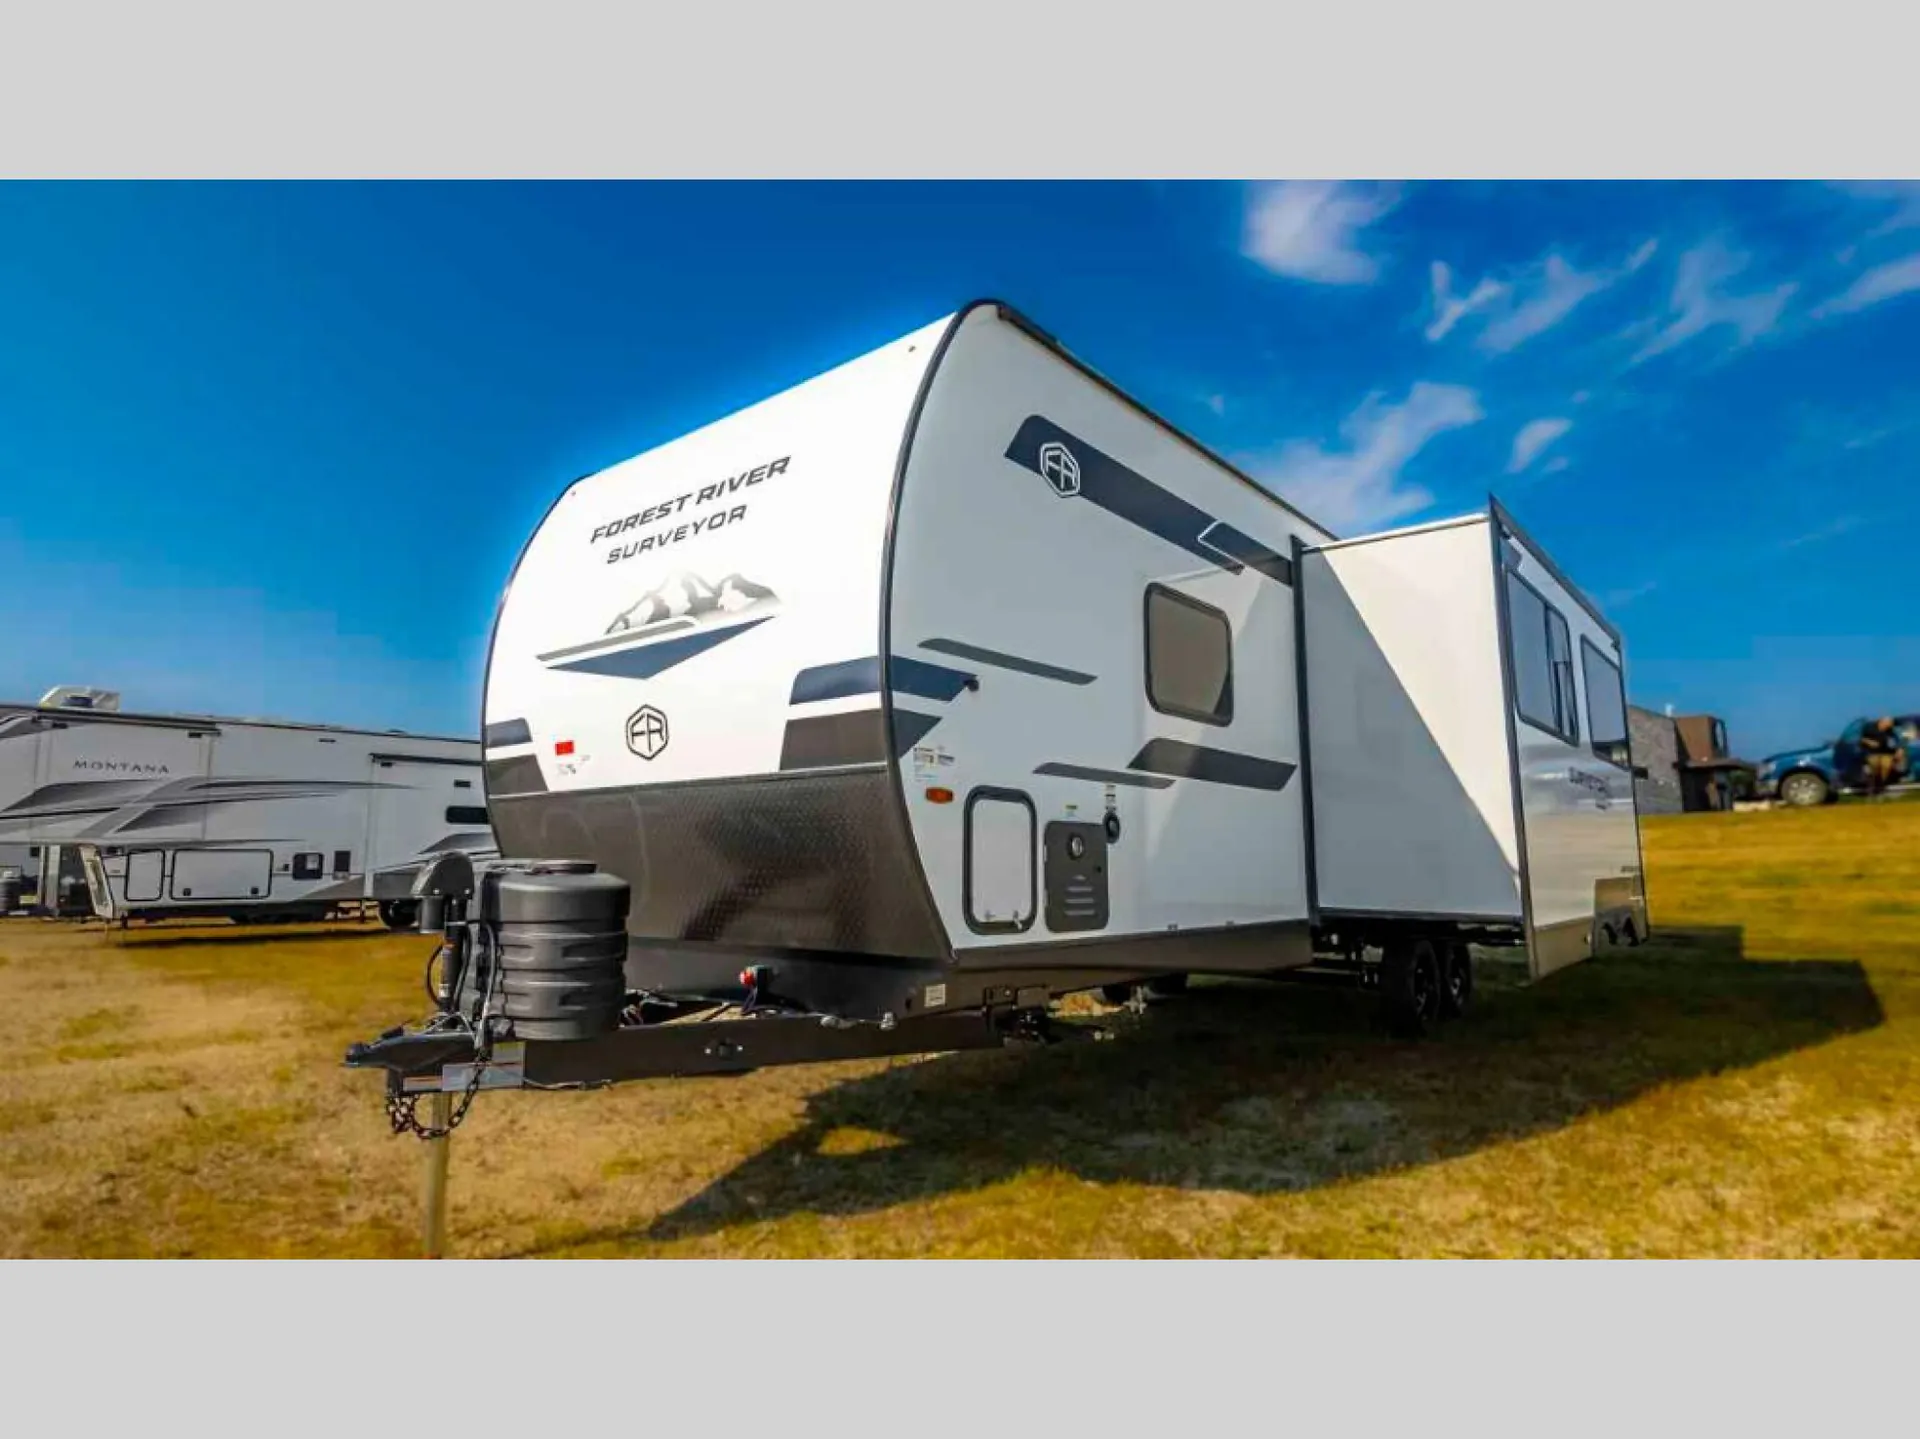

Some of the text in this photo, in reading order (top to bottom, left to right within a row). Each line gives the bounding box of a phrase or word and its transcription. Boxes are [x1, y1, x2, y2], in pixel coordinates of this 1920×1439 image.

[590, 455, 791, 544] FOREST RIVER
[606, 504, 748, 564] SURVEYOR
[73, 759, 170, 774] MONTANA
